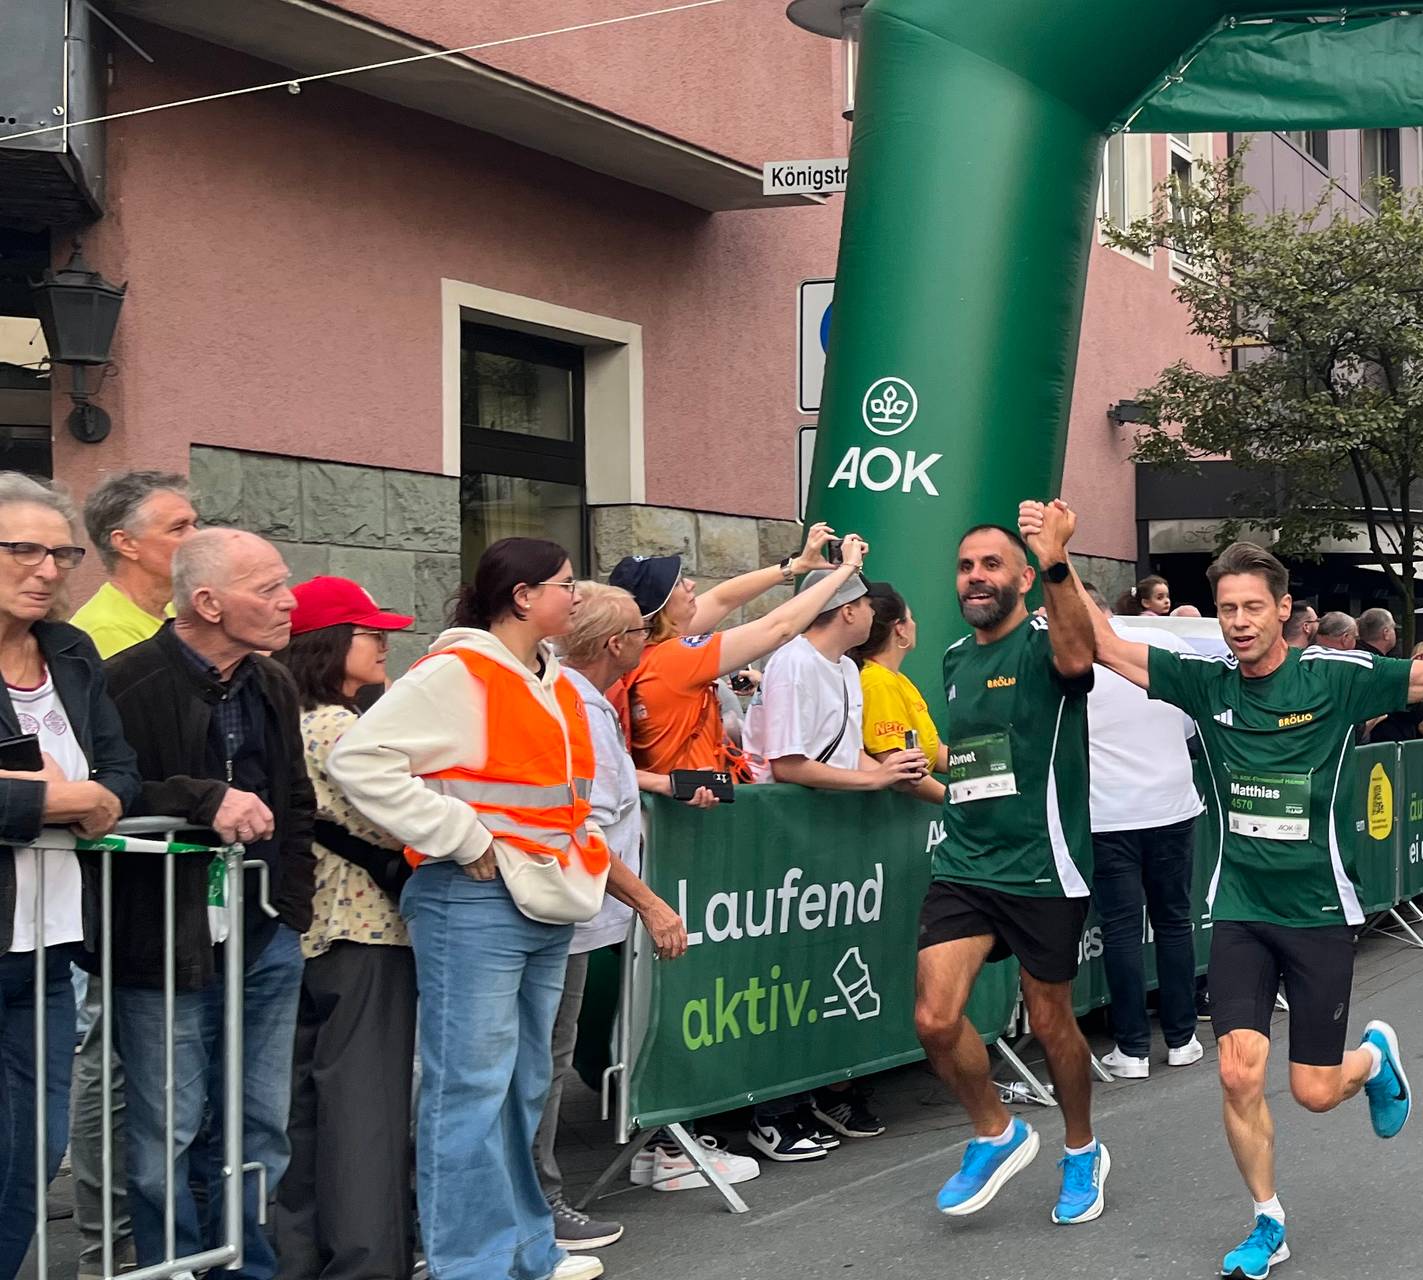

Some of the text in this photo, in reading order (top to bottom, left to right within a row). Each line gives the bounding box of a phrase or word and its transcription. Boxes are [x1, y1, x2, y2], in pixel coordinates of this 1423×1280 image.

[827, 446, 944, 497] AOK
[949, 750, 977, 767] Ahmet
[1230, 782, 1281, 799] Matthias
[1231, 798, 1253, 810] 4570
[678, 863, 884, 946] Laufend
[682, 964, 818, 1051] aktiv.
